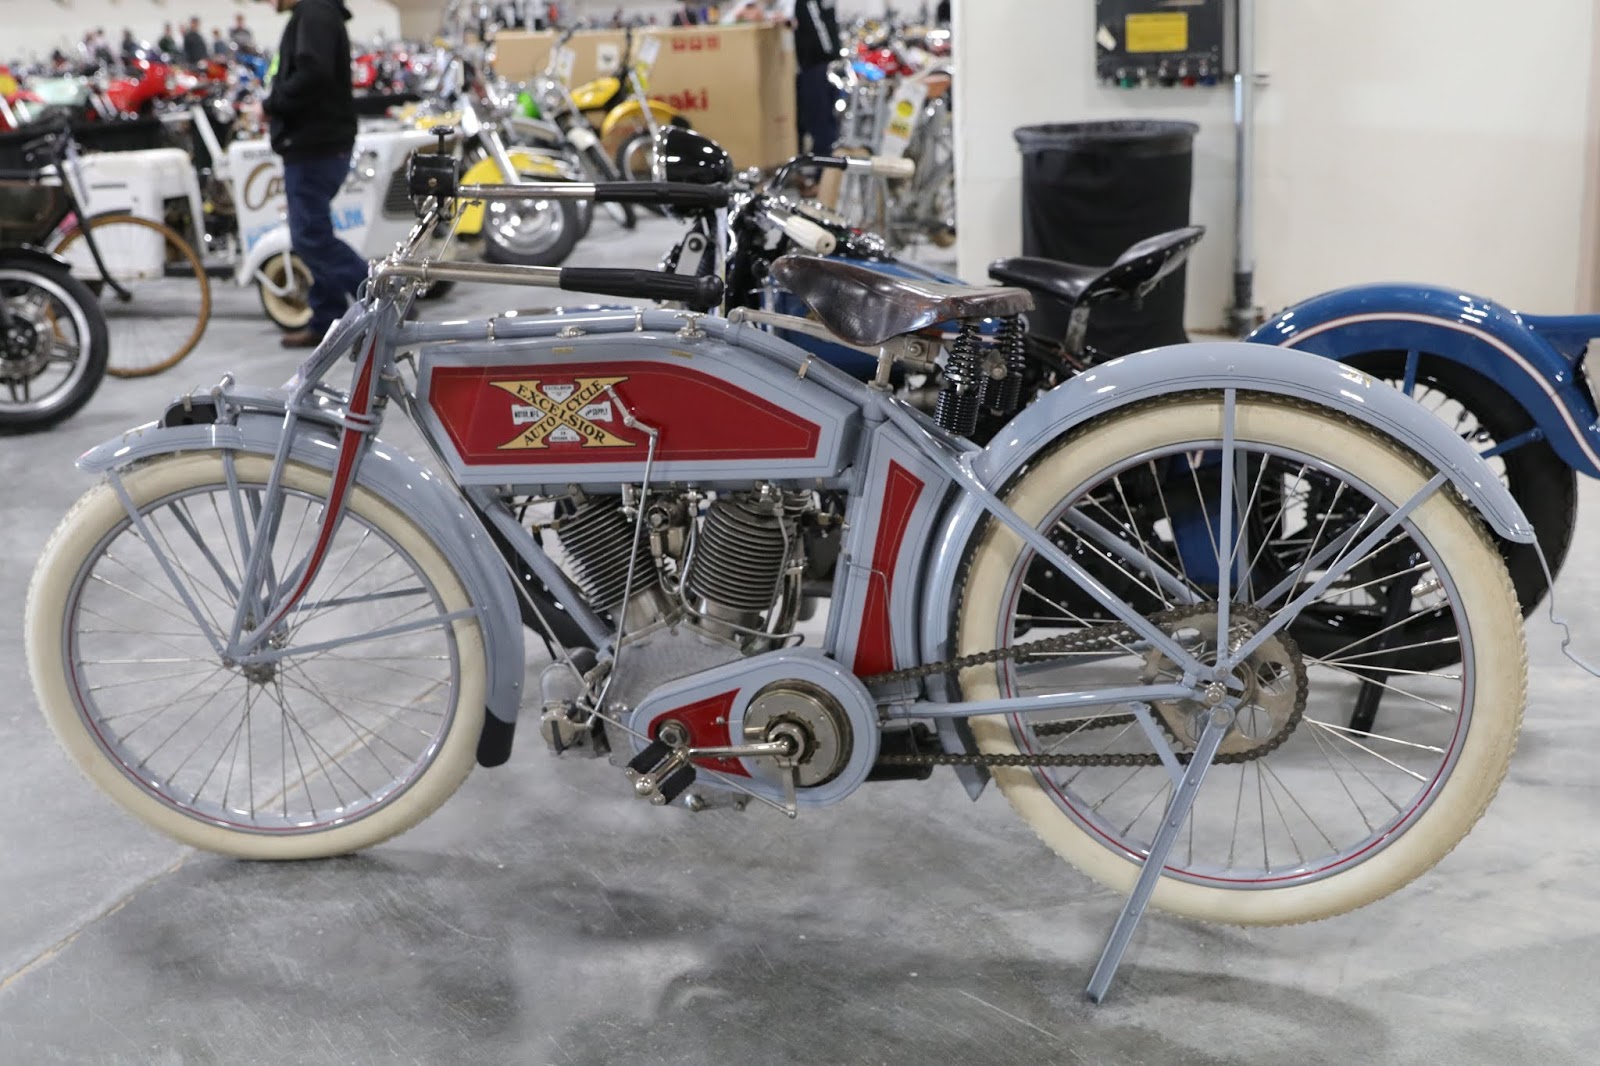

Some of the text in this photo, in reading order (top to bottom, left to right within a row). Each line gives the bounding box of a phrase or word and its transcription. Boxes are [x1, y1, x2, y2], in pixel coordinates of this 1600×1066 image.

[516, 384, 606, 444] EXCELSIOR
[524, 379, 604, 446] AUTO CYCLE
